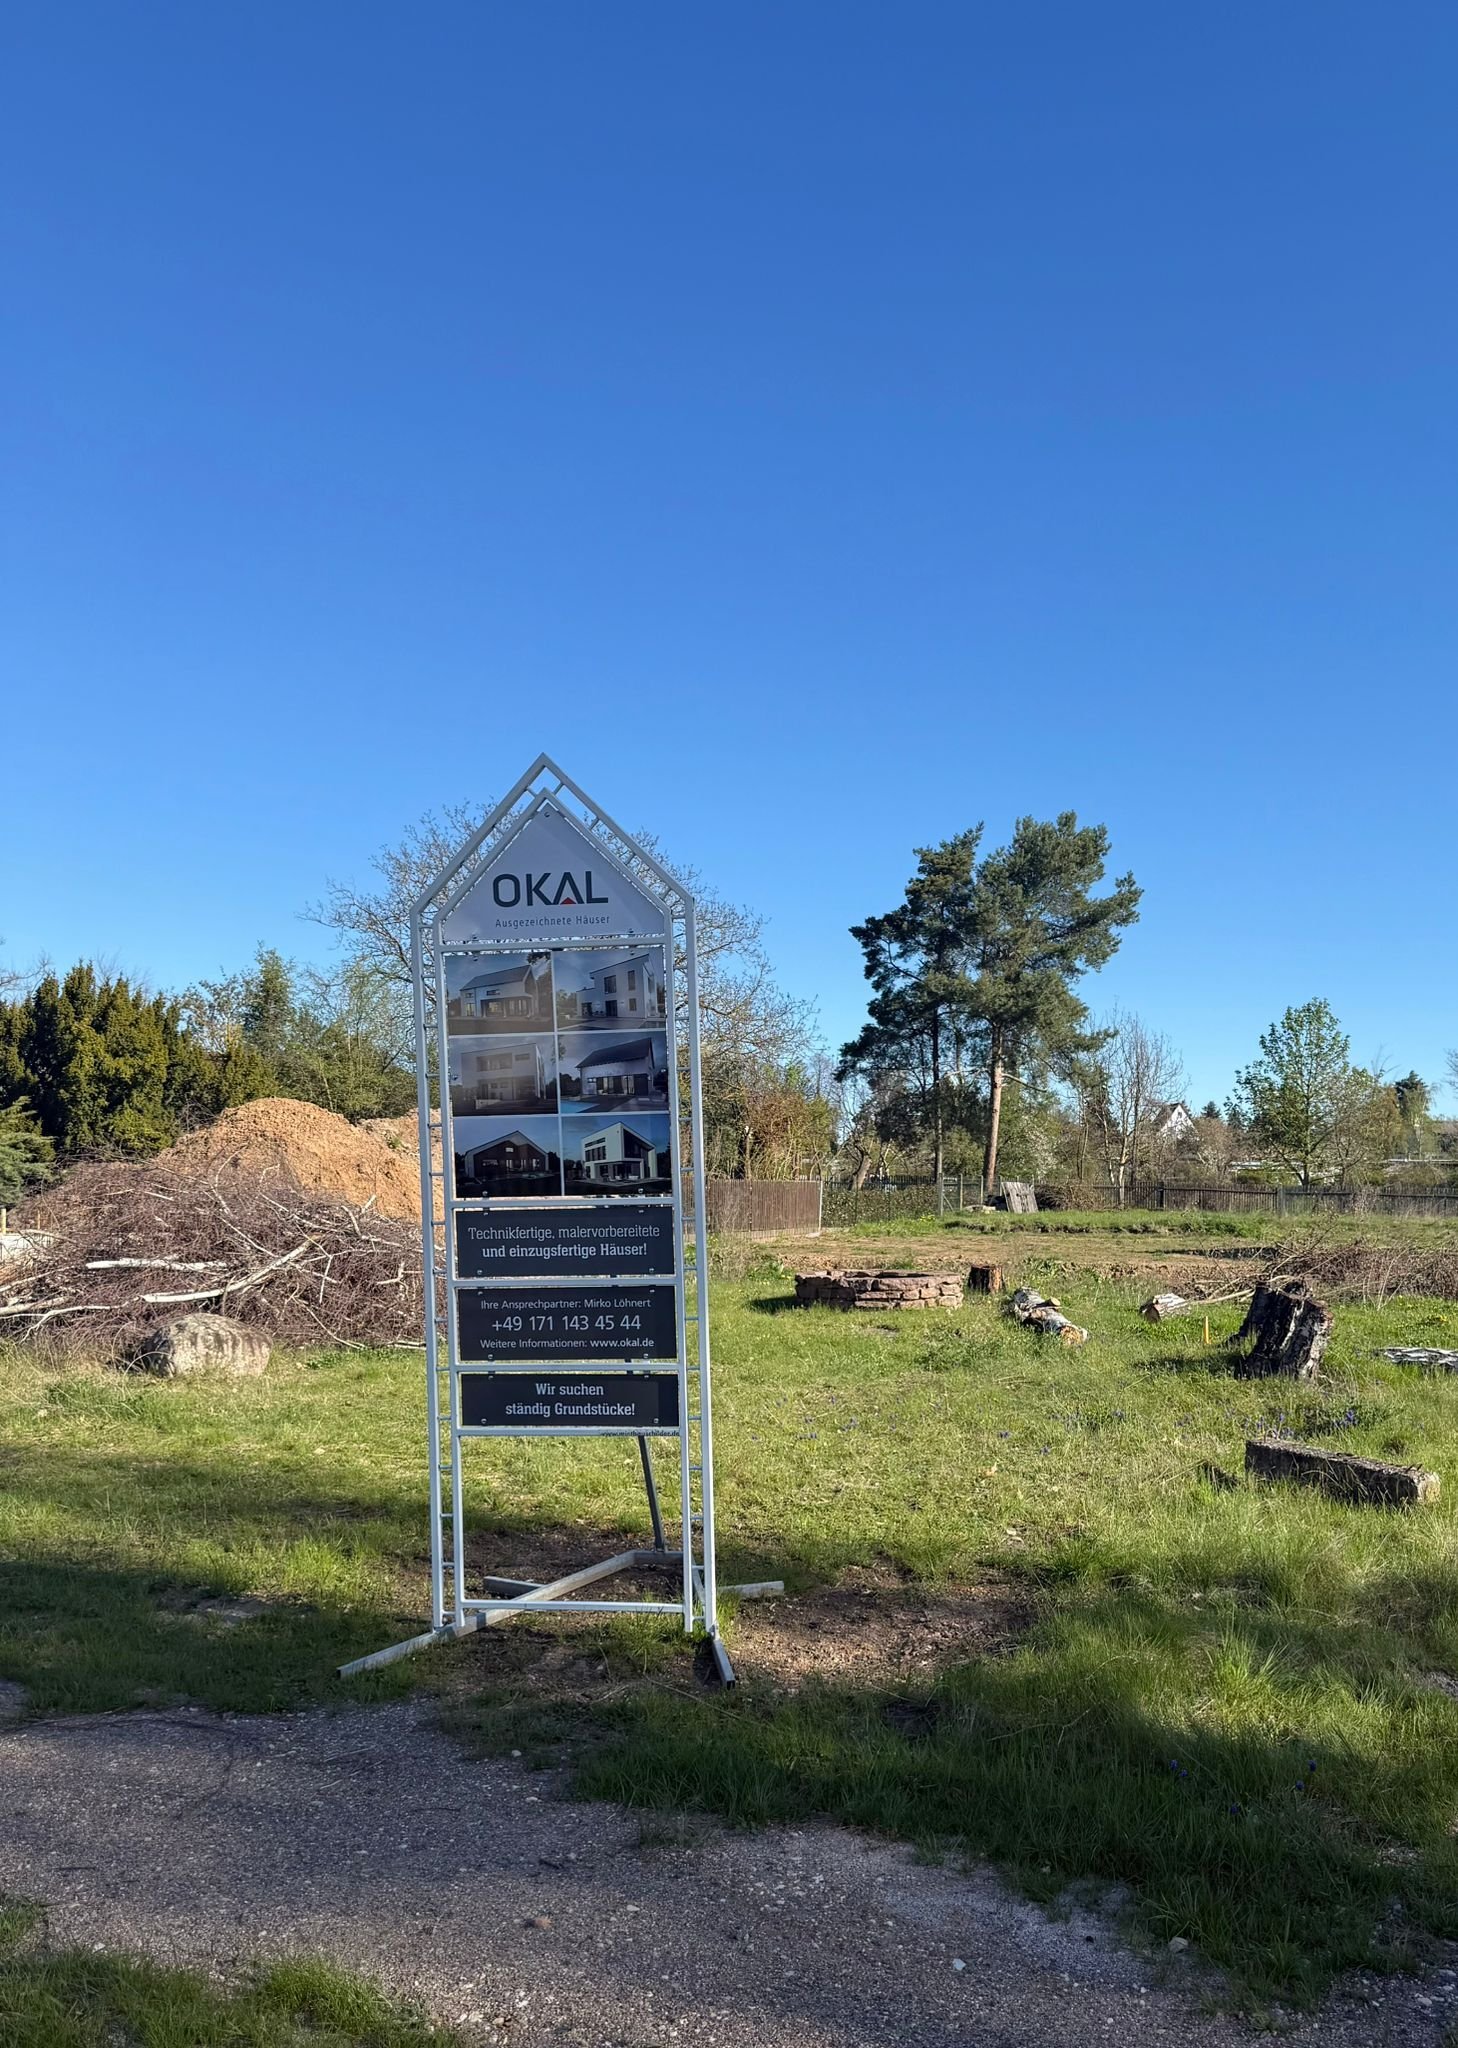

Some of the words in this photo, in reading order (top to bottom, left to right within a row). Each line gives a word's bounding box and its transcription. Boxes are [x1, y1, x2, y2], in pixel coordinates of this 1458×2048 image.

[493, 871, 608, 907] OKAL
[495, 917, 571, 929] Ausgezeichnete
[576, 915, 610, 925] Häuser
[468, 1226, 555, 1241] Technikfertige,
[558, 1224, 660, 1238] malervorbereitete
[482, 1245, 506, 1257] und
[509, 1244, 597, 1259] einzugsfertige
[600, 1242, 647, 1256] Häuser!
[481, 1300, 499, 1309] Ihre
[501, 1299, 581, 1310] Ansprechpartner:
[584, 1299, 611, 1308] Mirko
[614, 1298, 651, 1308] Löhnert
[492, 1316, 522, 1331] +49
[529, 1316, 553, 1331] 171
[562, 1315, 589, 1331] 143
[595, 1315, 615, 1330] 45
[620, 1315, 641, 1330] 44
[480, 1339, 517, 1349] Weitere
[519, 1338, 588, 1348] Informationen:
[590, 1337, 654, 1347] www.okal.de
[535, 1383, 556, 1395] Wir
[559, 1383, 604, 1396] suchen
[505, 1402, 551, 1418] ständig
[554, 1403, 635, 1416] Grundstücke!
